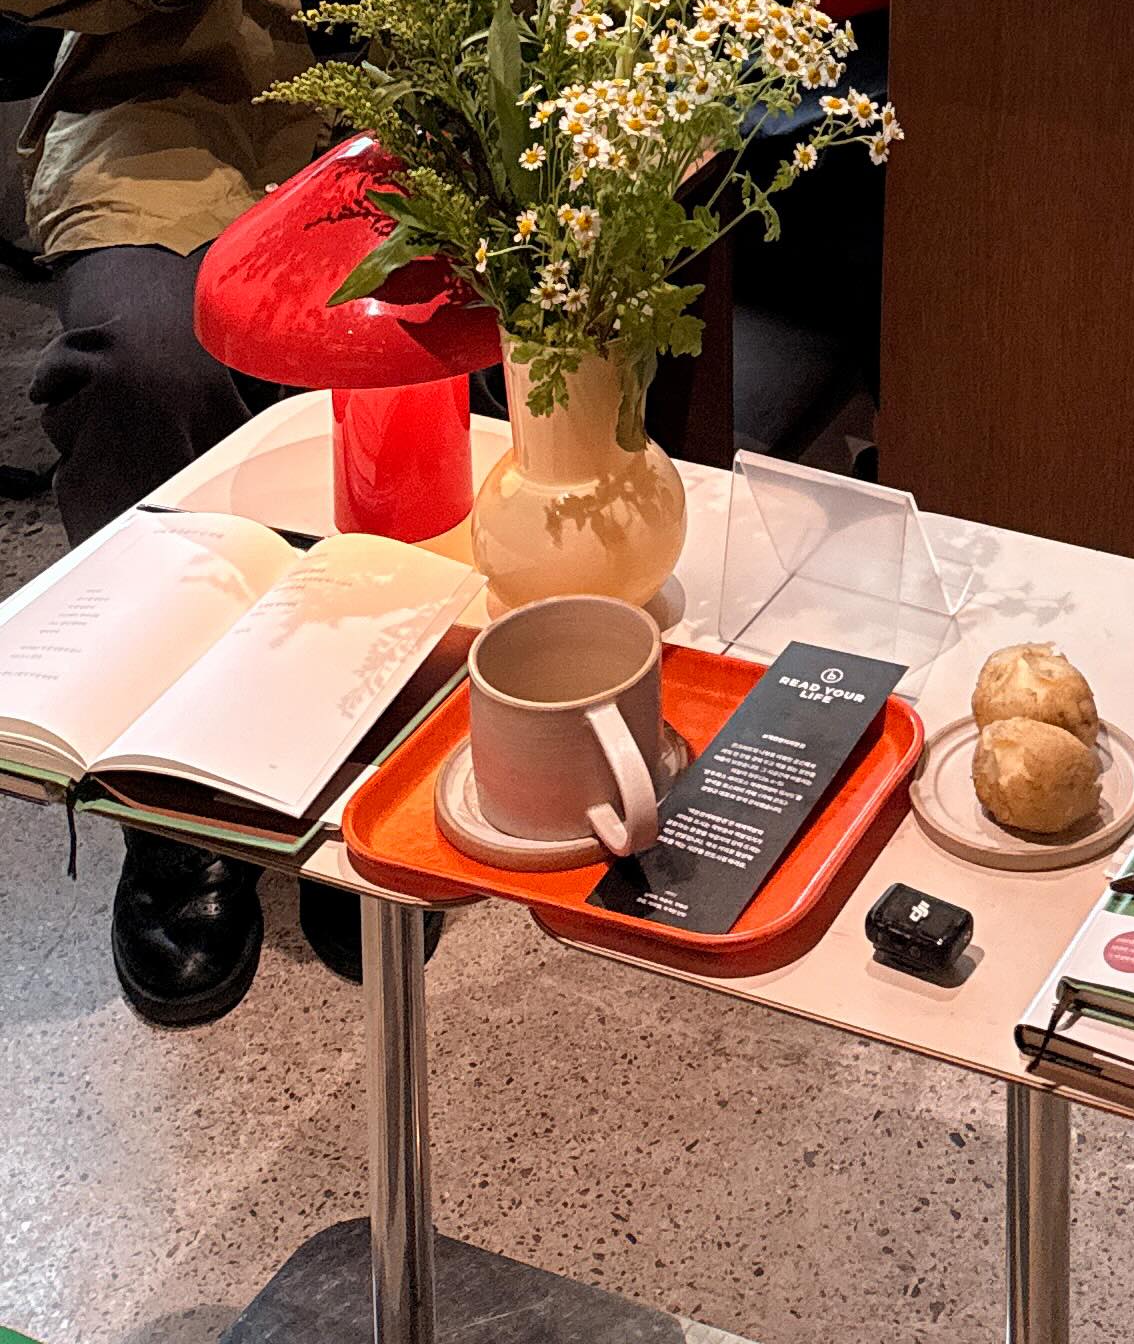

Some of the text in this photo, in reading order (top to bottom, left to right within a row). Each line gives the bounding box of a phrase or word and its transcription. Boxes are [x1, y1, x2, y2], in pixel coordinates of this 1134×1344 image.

[779, 675, 866, 703] READ YOUR
[799, 690, 835, 704] LIFE
